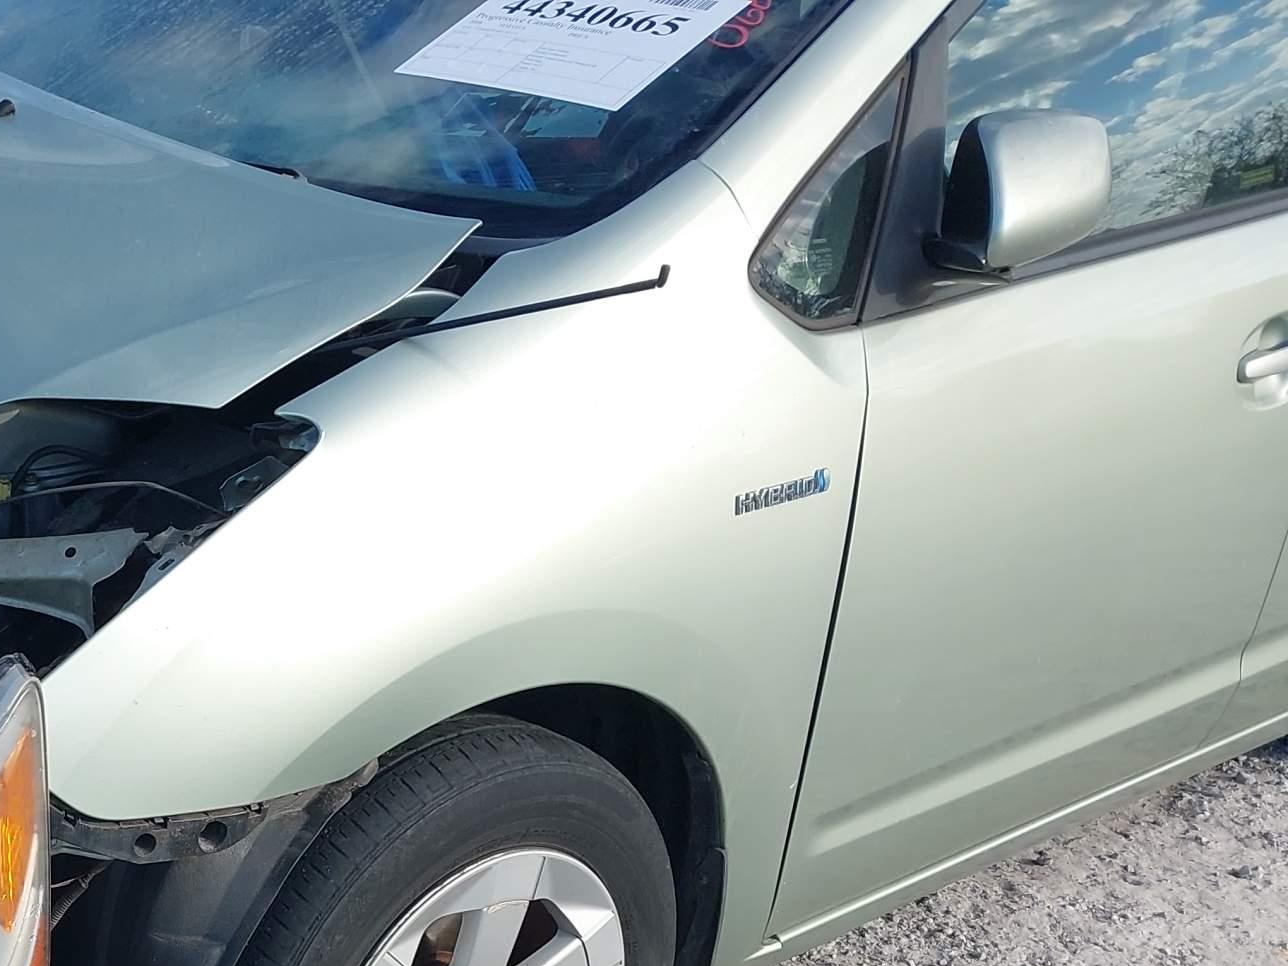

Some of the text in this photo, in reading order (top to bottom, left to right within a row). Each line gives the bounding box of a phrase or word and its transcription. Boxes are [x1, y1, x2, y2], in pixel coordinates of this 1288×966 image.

[476, 12, 526, 24] Progressive
[526, 18, 564, 30] Casualty
[567, 24, 612, 36] Insurance
[502, 0, 691, 36] 44340665
[734, 475, 818, 516] HYBRID
